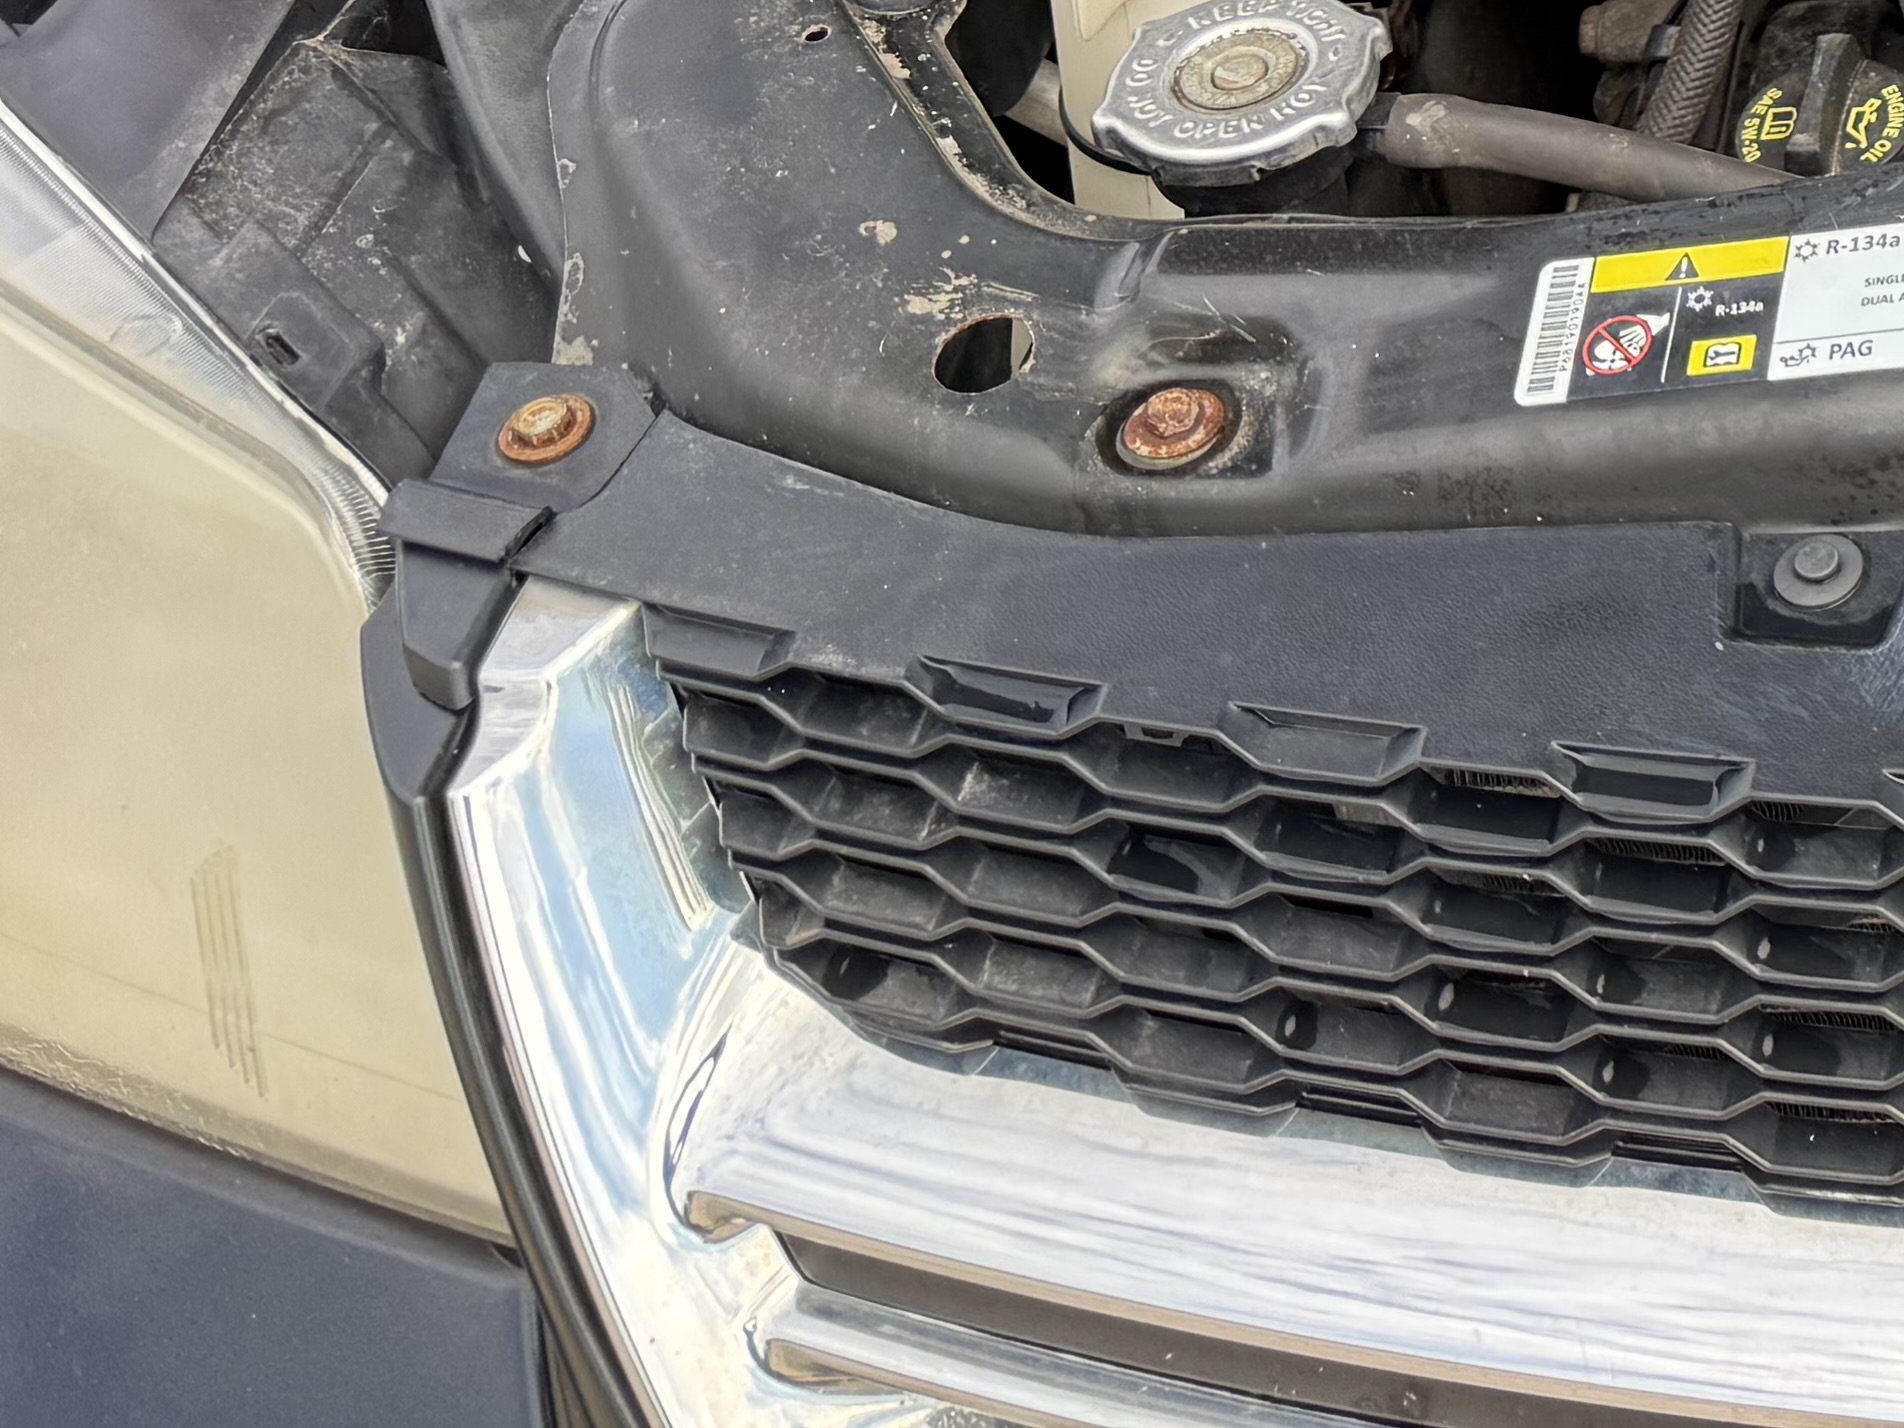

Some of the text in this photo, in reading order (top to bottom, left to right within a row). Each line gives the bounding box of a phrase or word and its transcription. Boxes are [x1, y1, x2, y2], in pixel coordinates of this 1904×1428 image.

[1751, 87, 1784, 116] SAE
[1174, 115, 1266, 138] OPEN
[1859, 139, 1892, 164] OIL
[1825, 232, 1901, 256] R-134a
[1715, 300, 1764, 317] R-134a
[1860, 294, 1896, 307] DUAL
[1827, 340, 1874, 361] PAG
